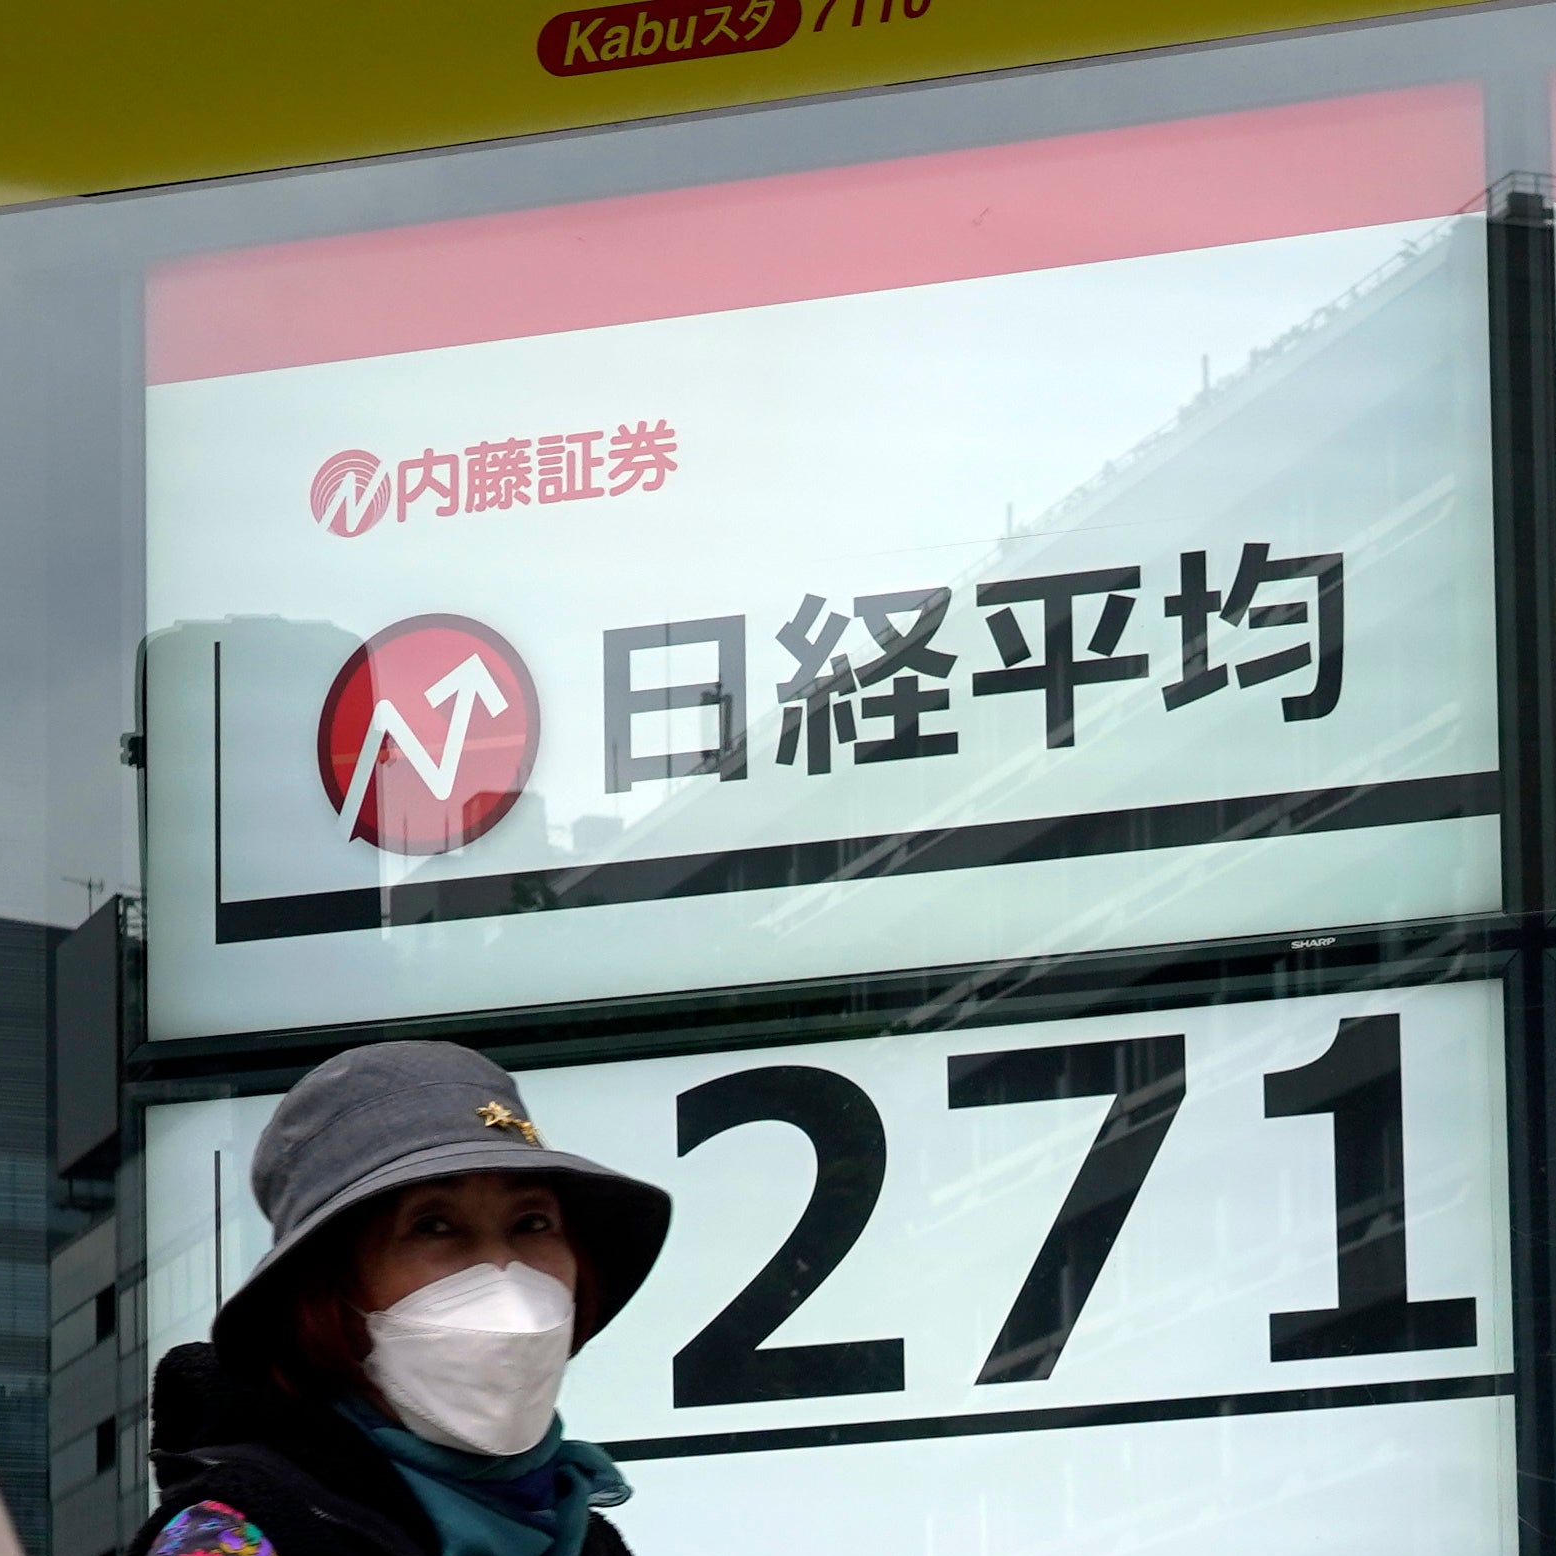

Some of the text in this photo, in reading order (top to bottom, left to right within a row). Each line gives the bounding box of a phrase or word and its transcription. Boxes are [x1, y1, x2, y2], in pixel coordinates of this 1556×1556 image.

[396, 418, 678, 523] 内藤証券
[602, 542, 1346, 795] 日経平均
[1290, 937, 1336, 949] SHARP
